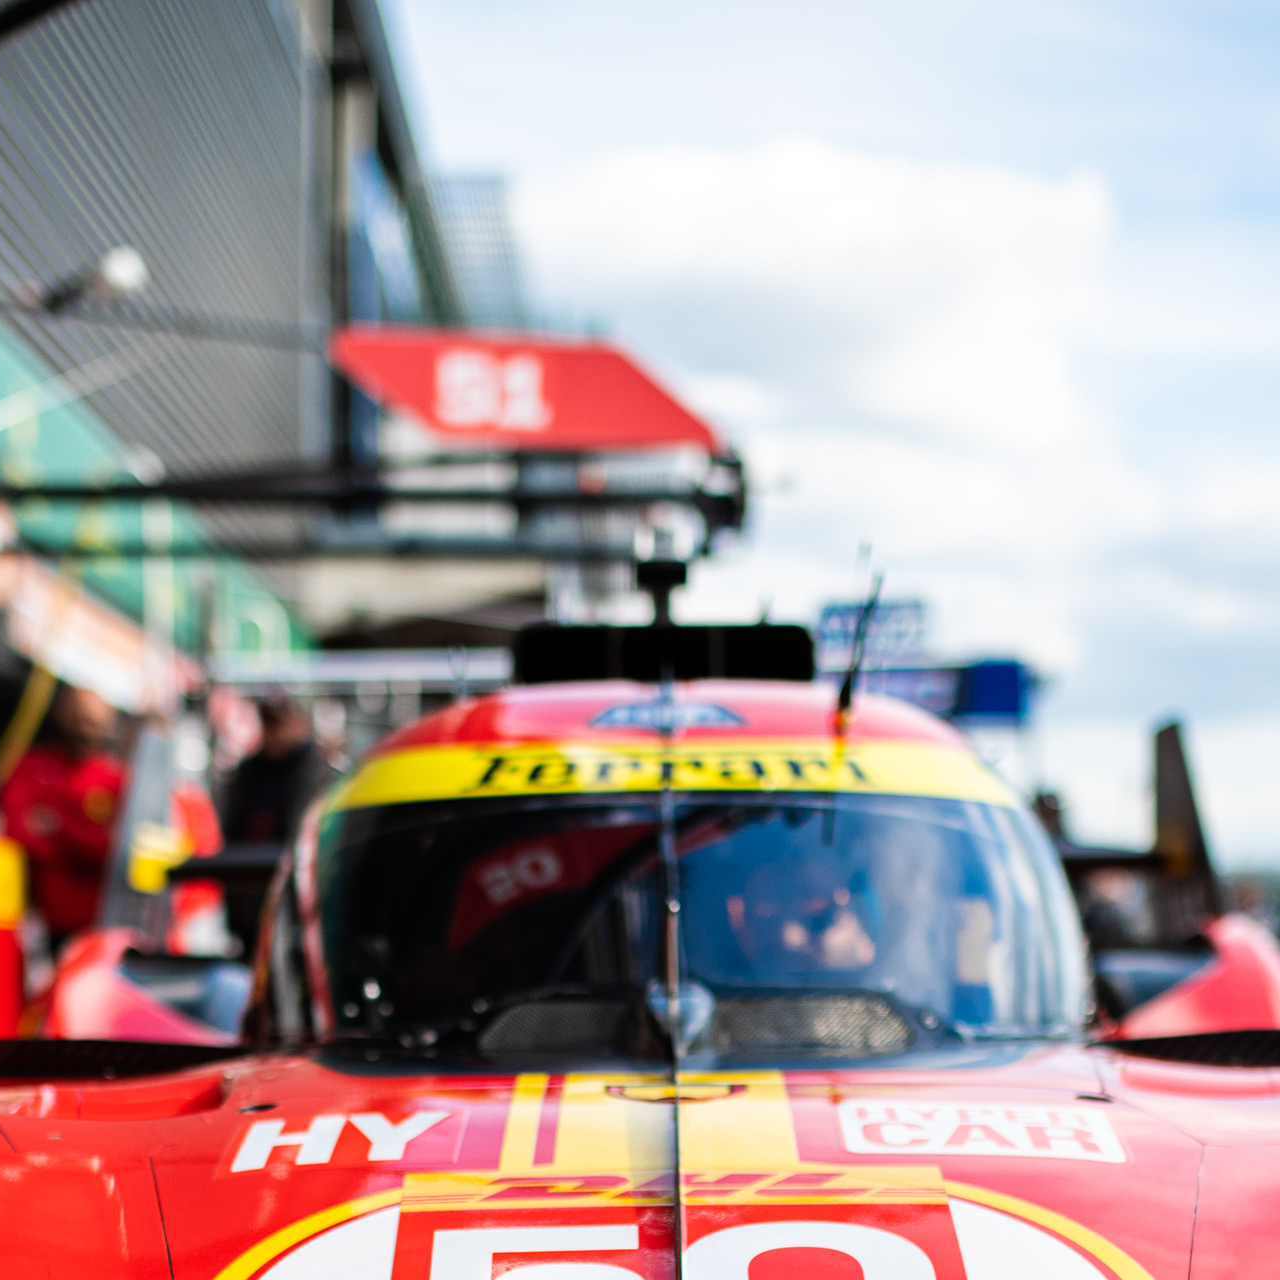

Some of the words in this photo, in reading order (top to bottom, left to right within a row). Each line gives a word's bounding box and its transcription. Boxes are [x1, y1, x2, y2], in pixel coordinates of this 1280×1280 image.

[465, 752, 872, 793] Ferrari
[230, 1111, 453, 1173] HY
[861, 1122, 1105, 1155] CAR
